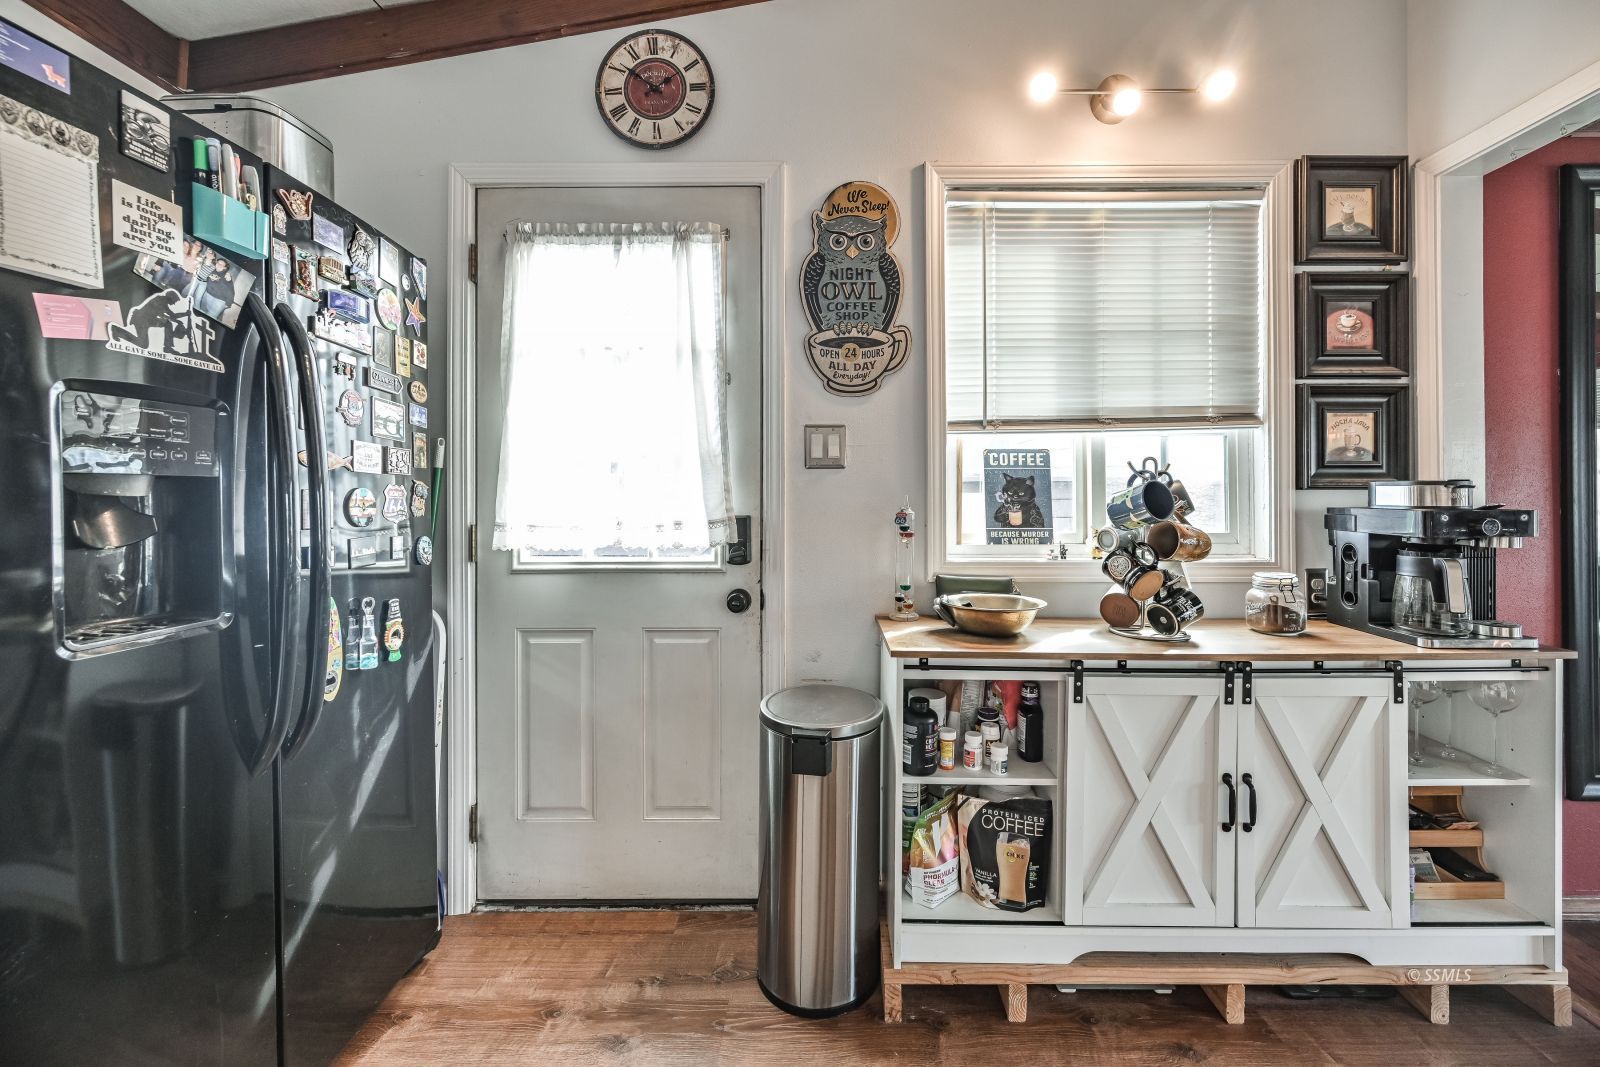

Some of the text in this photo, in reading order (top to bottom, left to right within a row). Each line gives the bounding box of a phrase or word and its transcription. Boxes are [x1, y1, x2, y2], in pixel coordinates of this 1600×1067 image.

[136, 195, 161, 211] Life
[847, 189, 868, 203] We
[121, 197, 176, 226] is tough,
[827, 199, 890, 217] Never Sleep!
[139, 213, 160, 226] my
[122, 214, 175, 241] darling,
[129, 224, 169, 244] but so
[122, 231, 147, 244] are
[149, 240, 176, 255] you.
[829, 266, 874, 281] NIGHT
[821, 281, 883, 301] OWL
[826, 301, 877, 313] COFFEE
[835, 311, 870, 321] SHOP
[109, 342, 123, 351] ALL
[125, 345, 146, 356] GAVE
[193, 360, 211, 370] GAVE
[212, 364, 223, 372] ALL
[819, 347, 885, 360] OPEN 24 HOURS
[828, 360, 877, 373] ALL DAY
[832, 370, 871, 384] Everyday!
[989, 452, 1046, 466] COFFEE
[1011, 537, 1040, 545] WRONG
[982, 808, 1045, 823] PROTEIN ICED
[981, 814, 1045, 837] COFFEE
